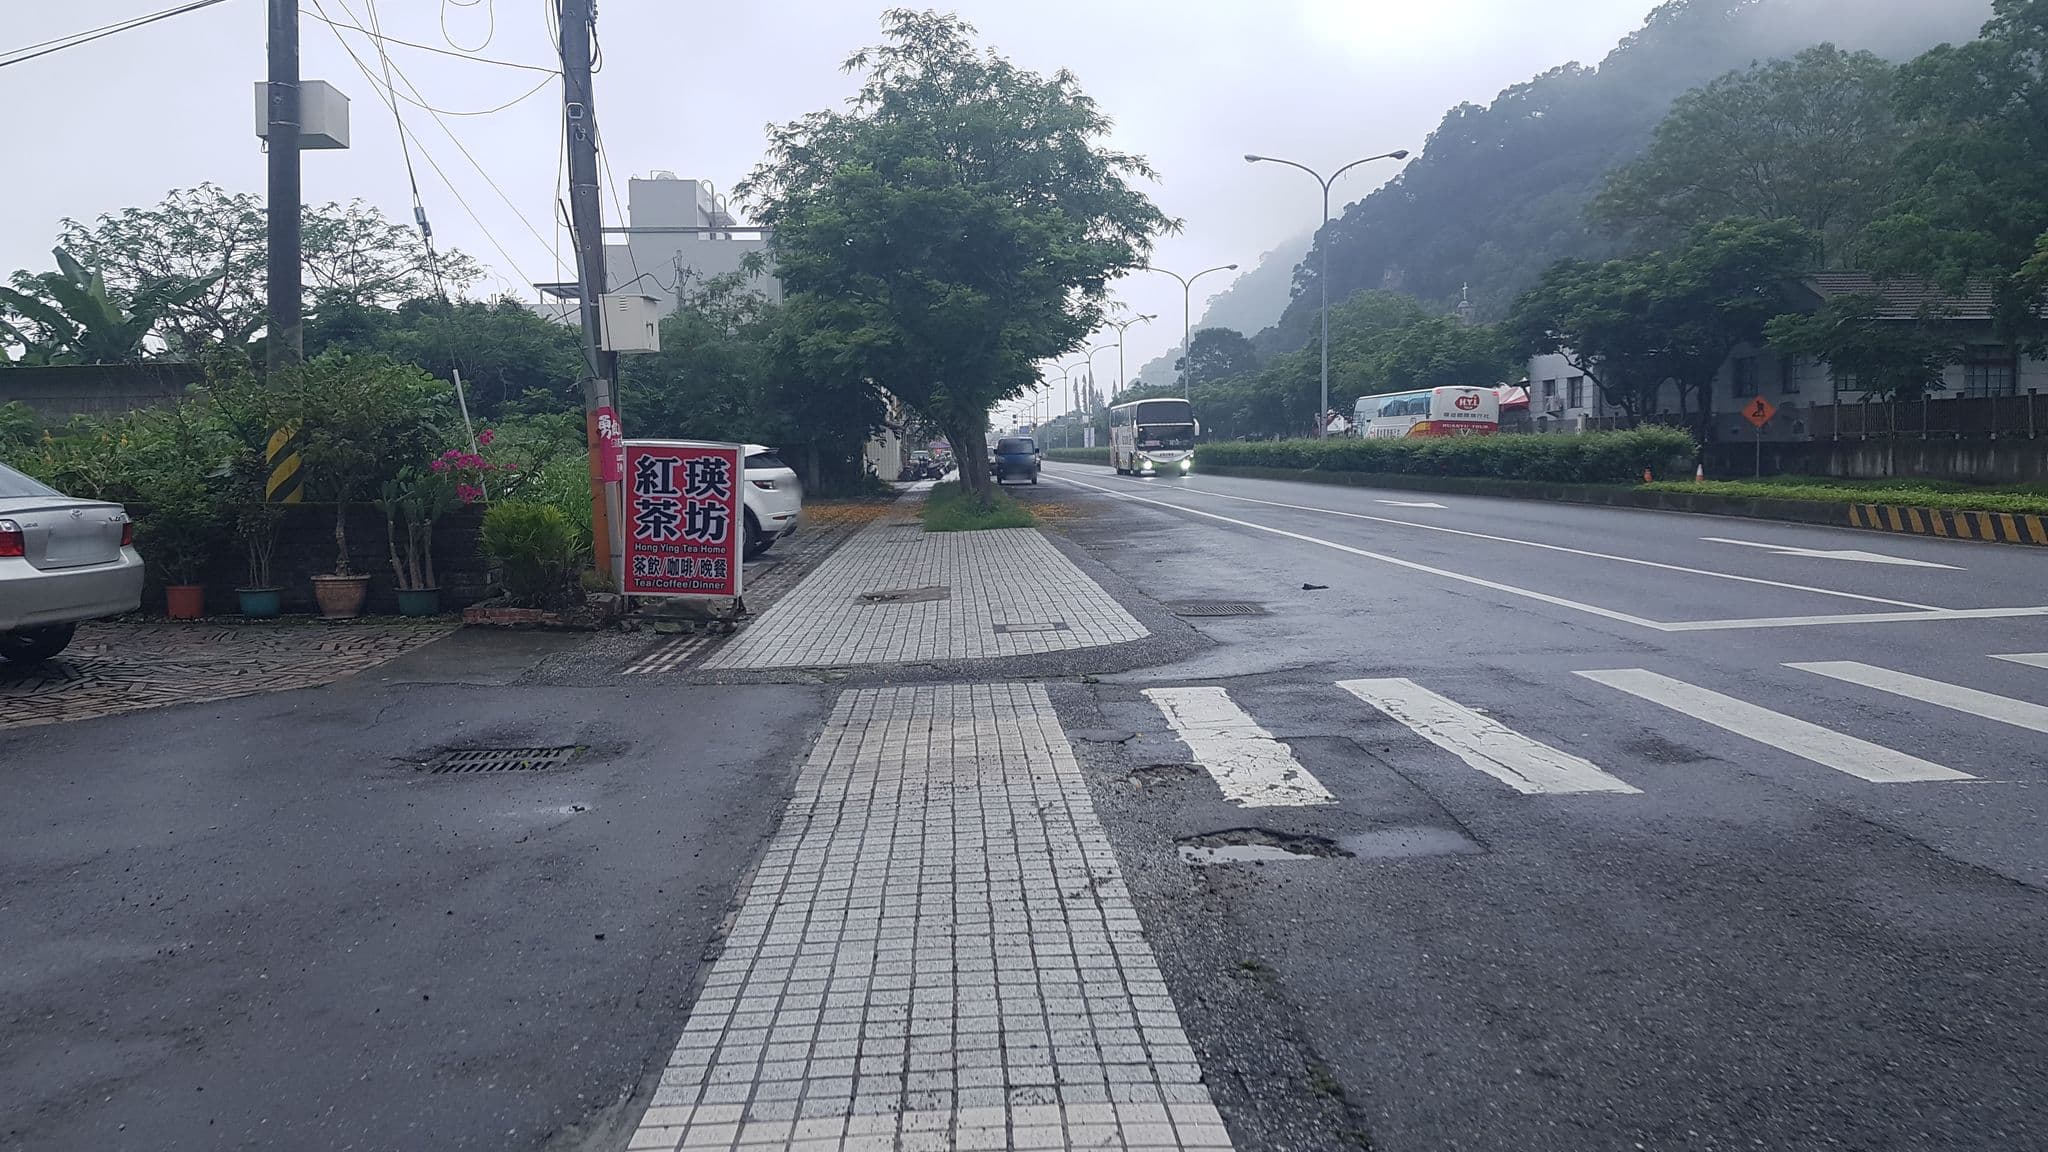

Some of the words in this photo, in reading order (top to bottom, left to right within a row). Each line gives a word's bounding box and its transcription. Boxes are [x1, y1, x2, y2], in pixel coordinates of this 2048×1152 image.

[634, 454, 731, 499] 紅瑛
[634, 498, 730, 543] 茶坊
[634, 543, 658, 553] Hong
[660, 543, 680, 554] Ying
[682, 544, 699, 553] Tea
[700, 545, 726, 554] Home
[633, 555, 728, 579] 茶飲/咖啡/晚餐
[634, 579, 725, 590] Tea/Coffee/Dinner
